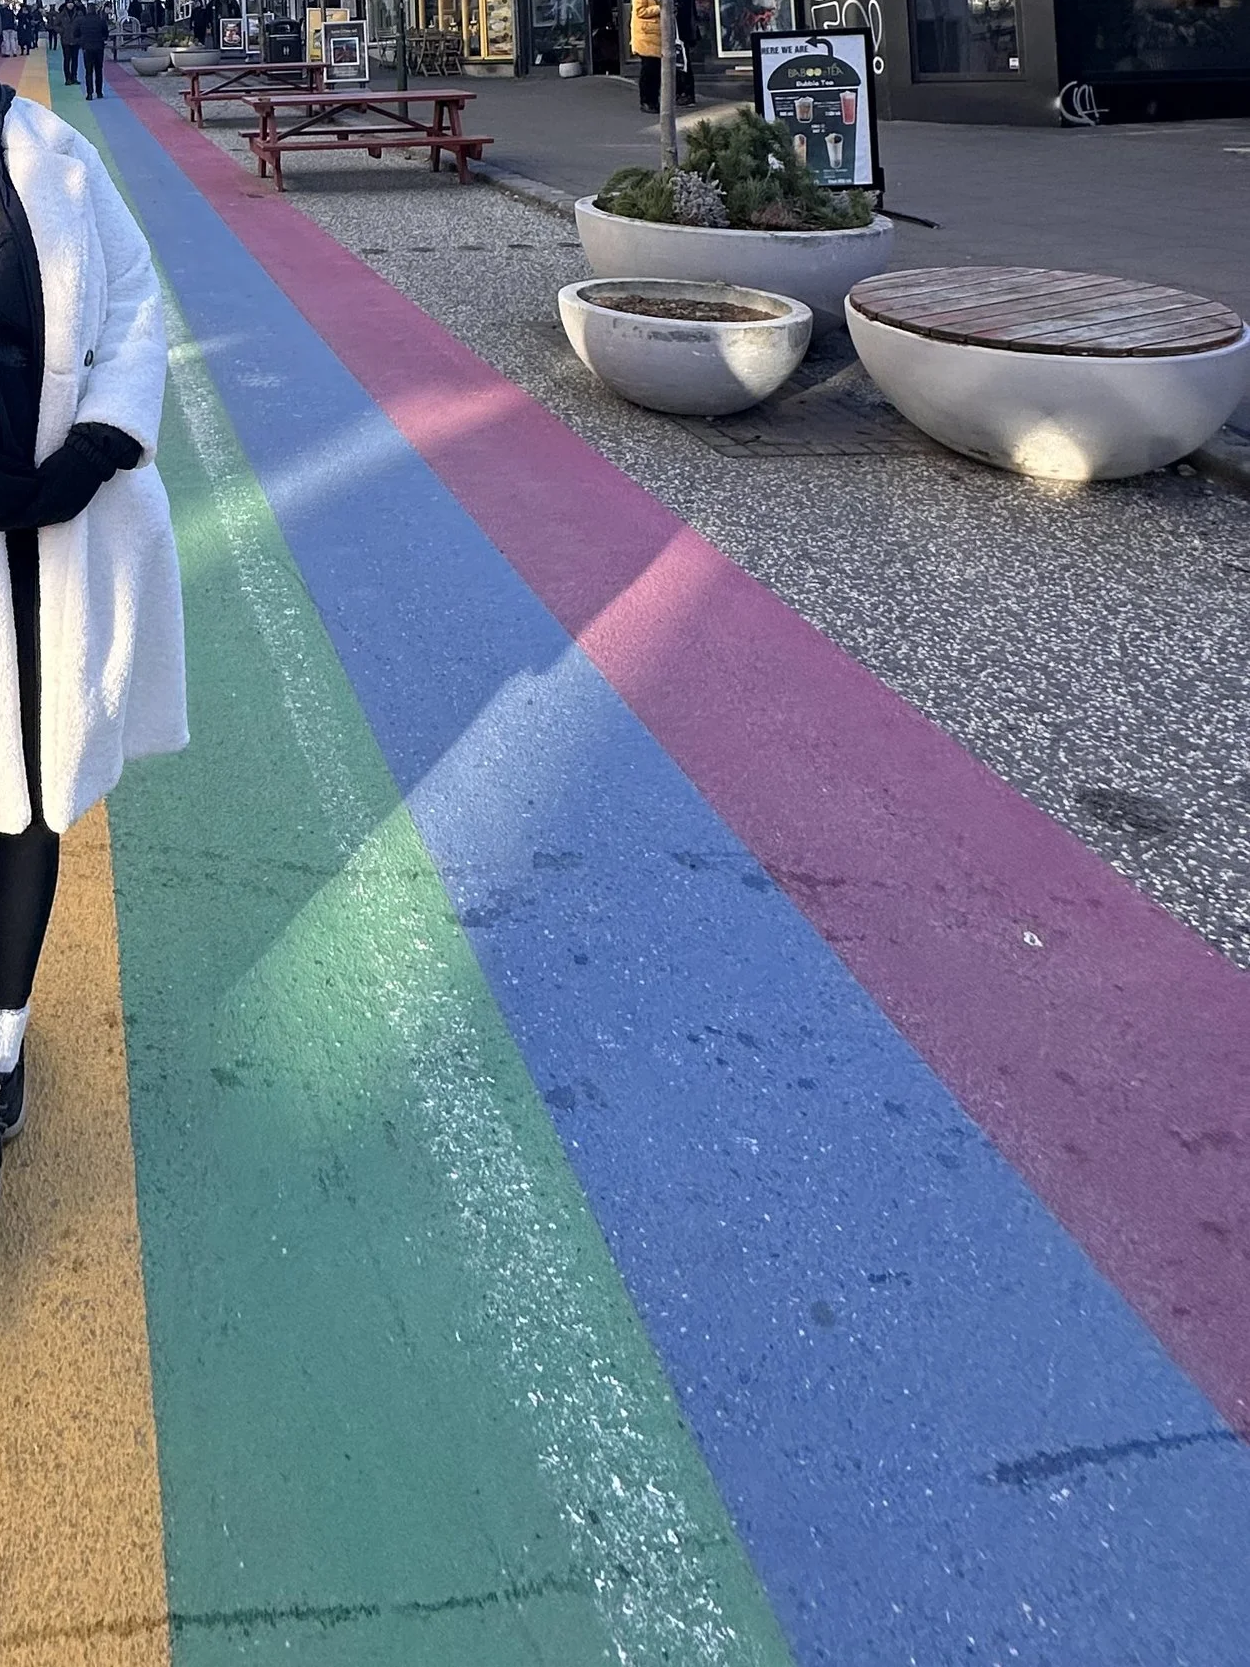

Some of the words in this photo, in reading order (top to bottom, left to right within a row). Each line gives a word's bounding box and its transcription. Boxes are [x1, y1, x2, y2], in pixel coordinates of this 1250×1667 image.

[761, 46, 779, 54] HERE
[781, 45, 792, 54] WE
[794, 45, 809, 53] ARE
